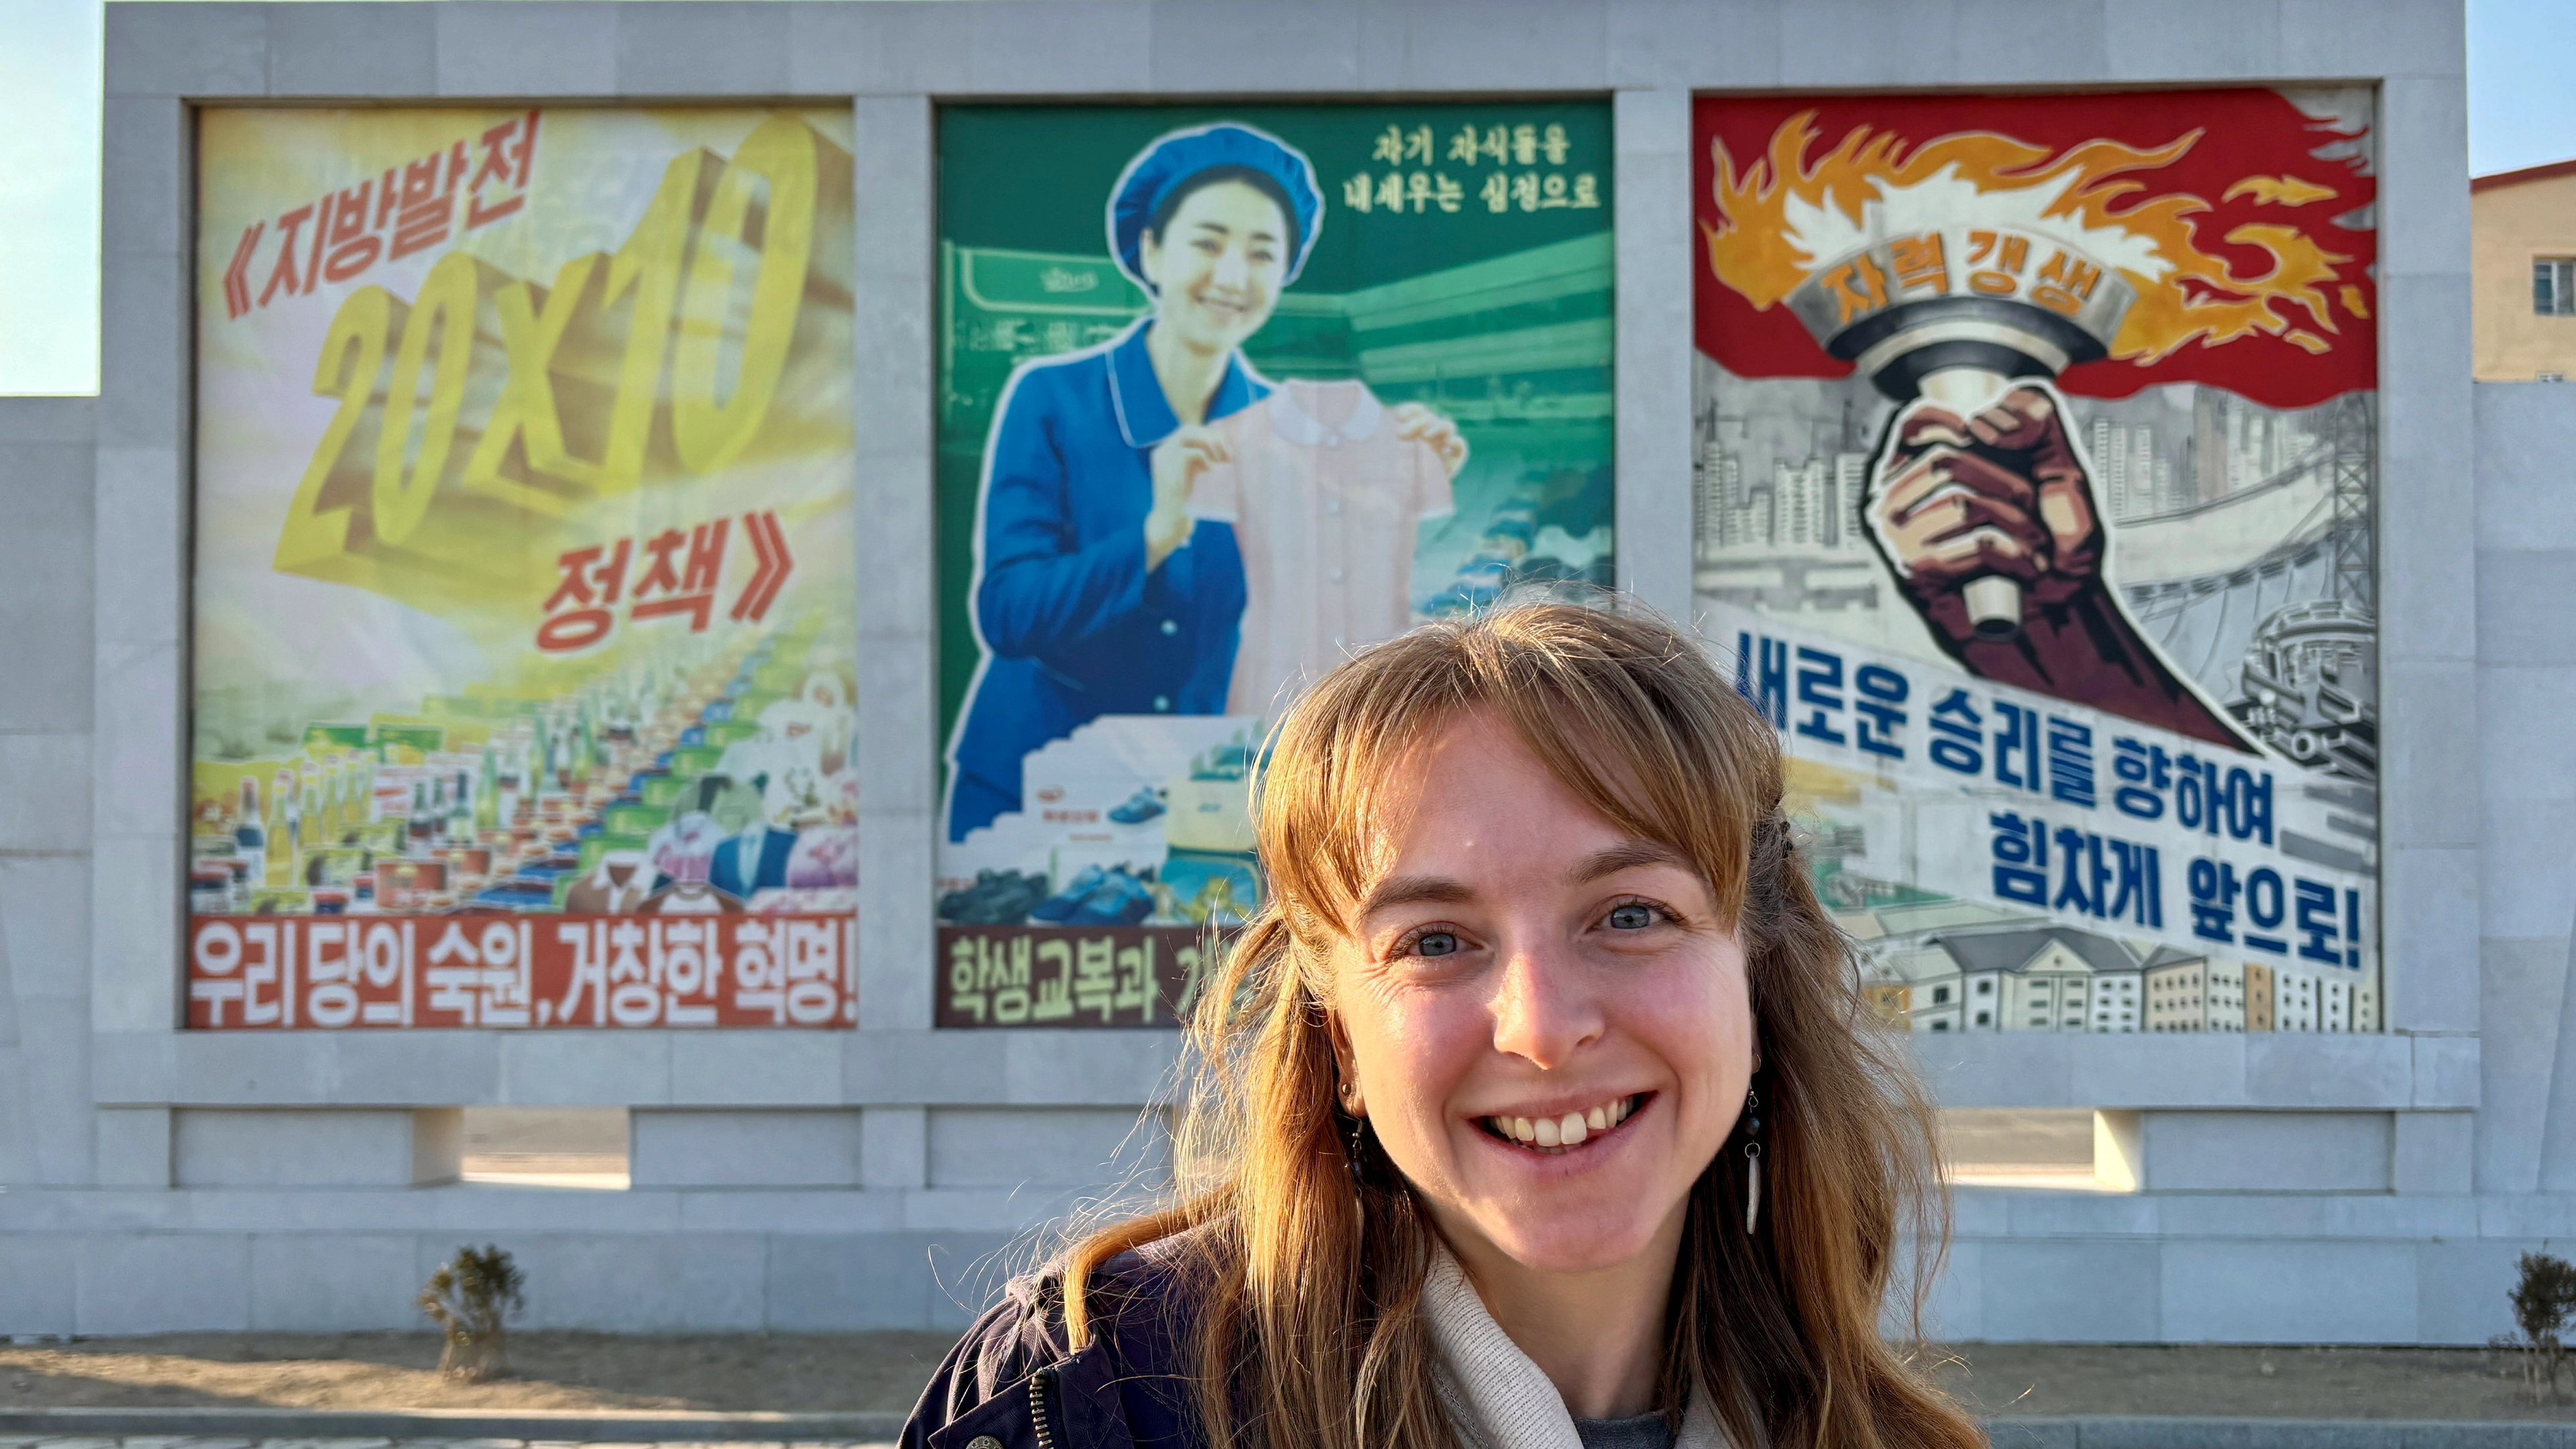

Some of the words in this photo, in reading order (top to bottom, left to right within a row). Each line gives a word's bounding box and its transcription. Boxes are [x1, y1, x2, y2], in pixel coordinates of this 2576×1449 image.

[1343, 172, 1464, 214] 내세우는
[1479, 172, 1601, 213] 심정으로
[1372, 123, 1433, 166] 자기
[1447, 123, 1571, 166] 자식들을
[1736, 628, 1908, 759] 새로운
[1928, 687, 2096, 810] 승리를
[2112, 735, 2273, 847] 향하여
[1990, 810, 2162, 928] 힘차게
[2189, 855, 2361, 970] 앞으로!
[191, 922, 294, 1026] 우리
[307, 922, 414, 1025] 당의
[559, 920, 722, 1025] 거창한
[735, 920, 857, 1025] 혁명!
[950, 934, 1159, 1023] 학생교복과
